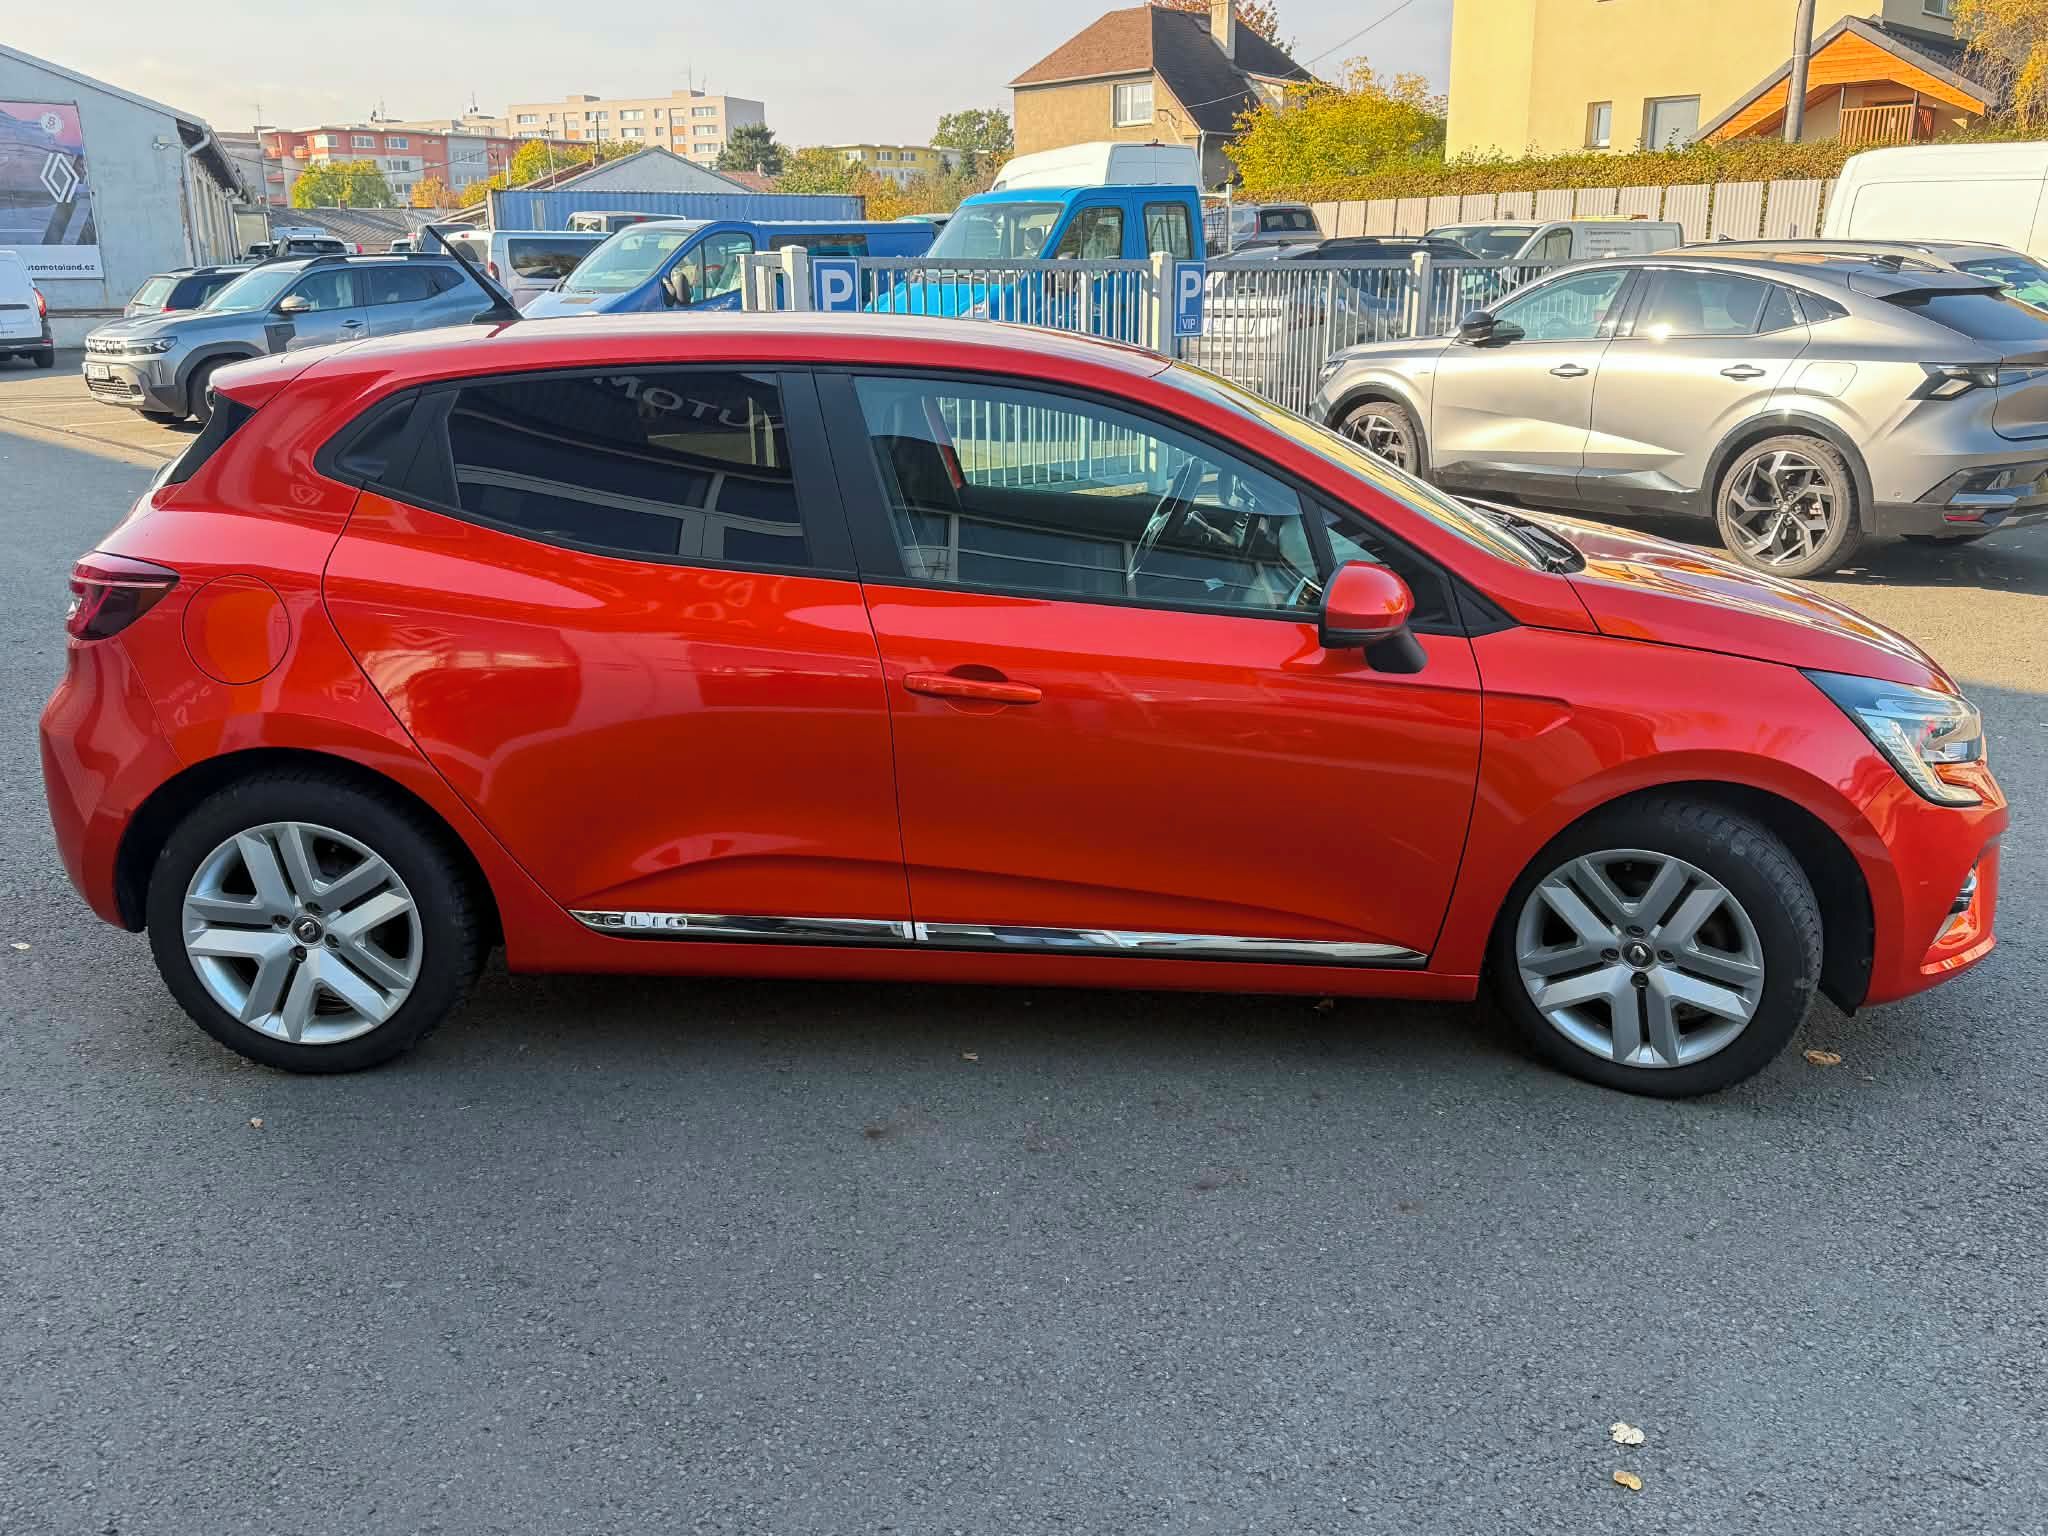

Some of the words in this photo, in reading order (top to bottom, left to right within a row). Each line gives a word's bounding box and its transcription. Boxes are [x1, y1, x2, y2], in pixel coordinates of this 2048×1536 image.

[821, 269, 853, 312] P
[1180, 270, 1202, 314] P
[1182, 318, 1196, 329] VIP
[604, 912, 688, 929] CLIO
